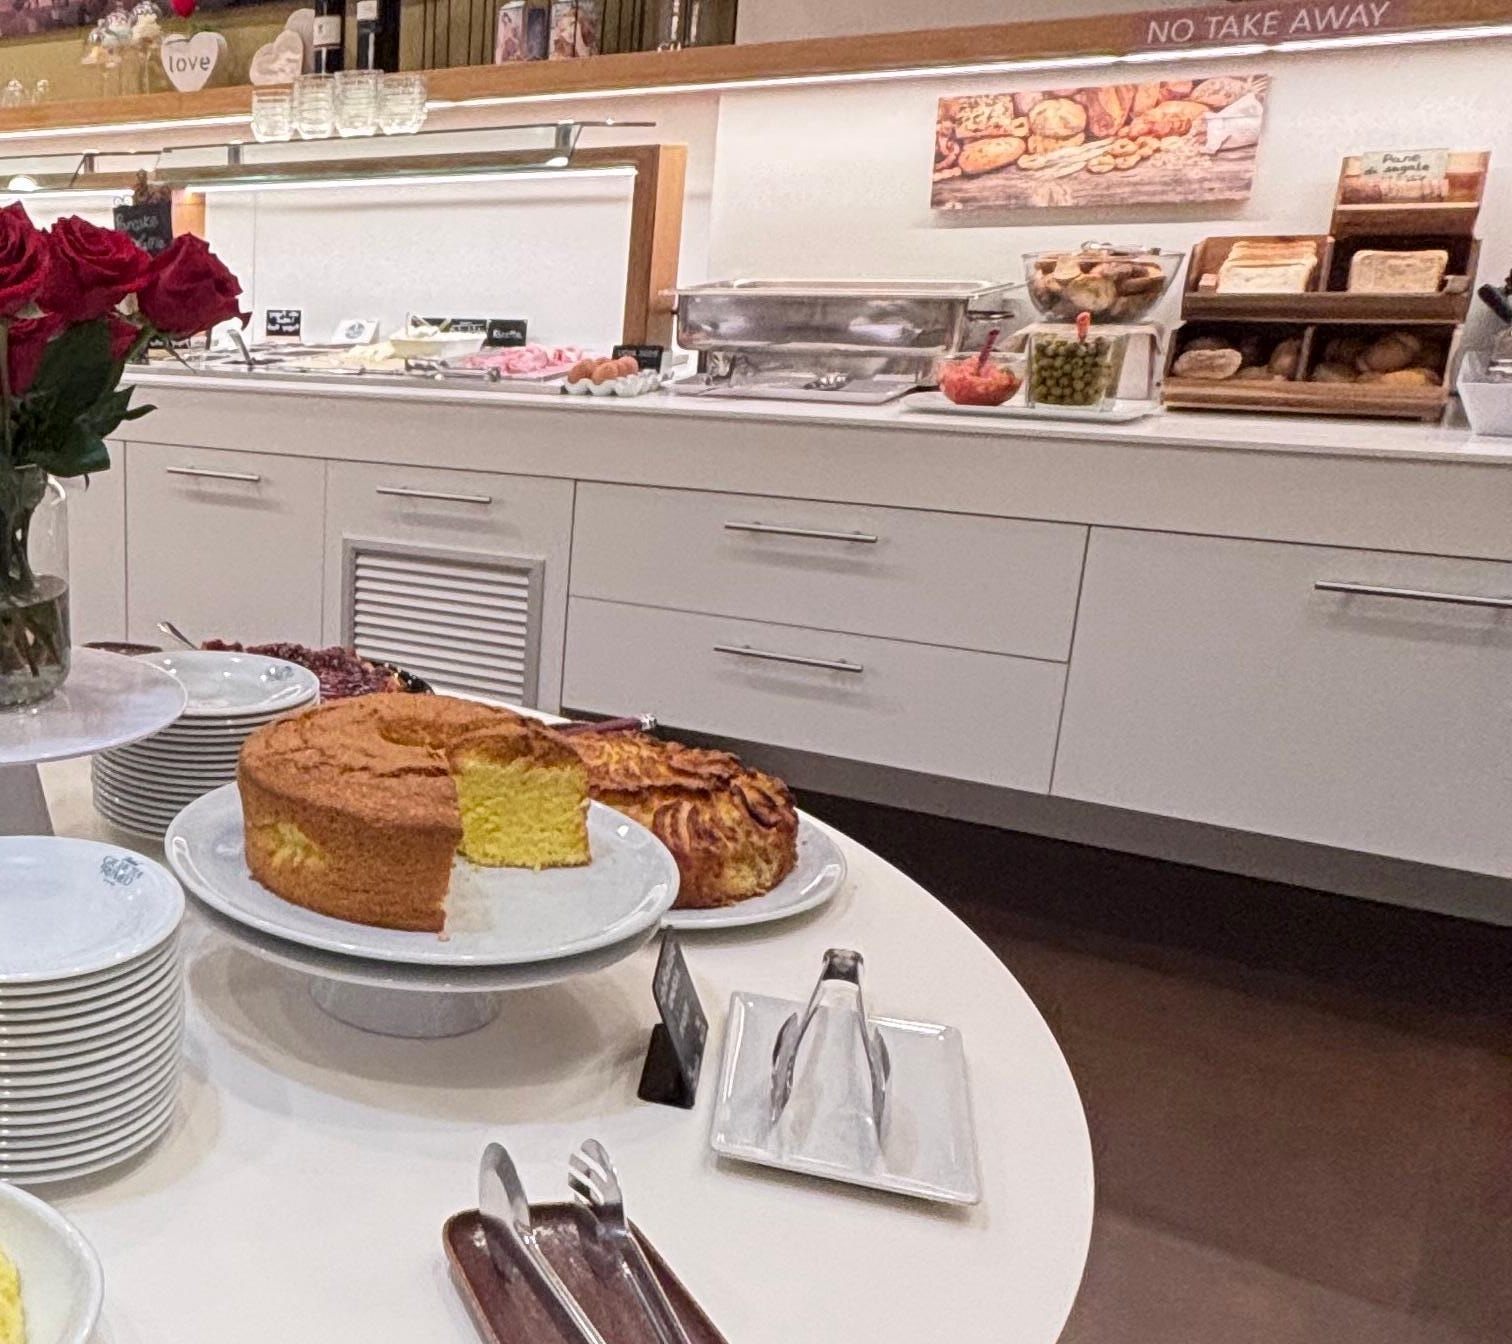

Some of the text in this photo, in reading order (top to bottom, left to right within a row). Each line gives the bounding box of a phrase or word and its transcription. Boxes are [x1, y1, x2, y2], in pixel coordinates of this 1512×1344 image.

[1146, 0, 1391, 44] NO TAKE AWAY
[168, 55, 211, 73] love
